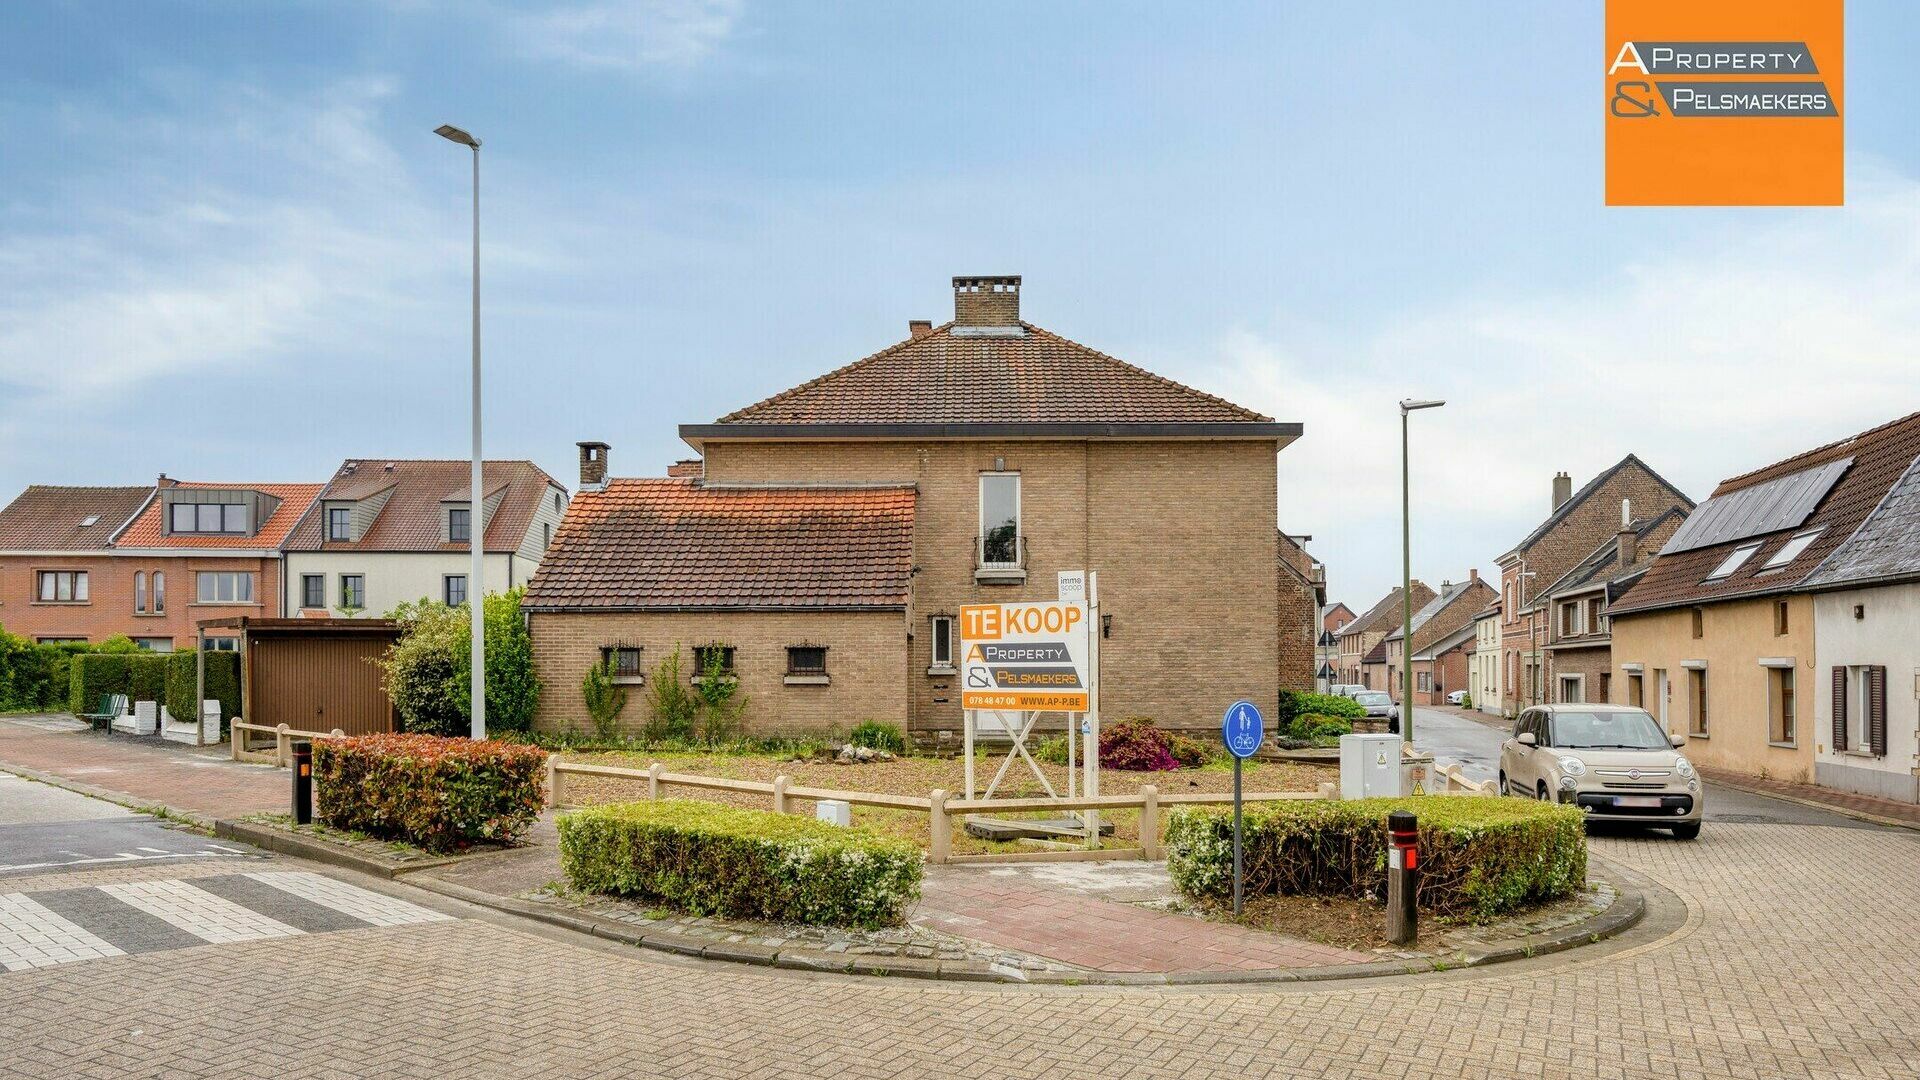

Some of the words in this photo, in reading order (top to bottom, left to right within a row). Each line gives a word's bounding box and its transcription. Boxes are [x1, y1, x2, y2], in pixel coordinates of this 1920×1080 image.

[966, 609, 998, 635] TE
[1005, 606, 1081, 634] KOOP
[966, 643, 986, 663] A
[986, 646, 1064, 660] PROPERTY
[967, 666, 992, 688] &
[997, 670, 1077, 684] PELSMAEKERS
[969, 696, 983, 705] 078
[984, 696, 994, 705] 48
[995, 696, 1005, 705] 47
[1006, 697, 1016, 706] 00
[1020, 697, 1080, 706] WWW.AP-P.BE
